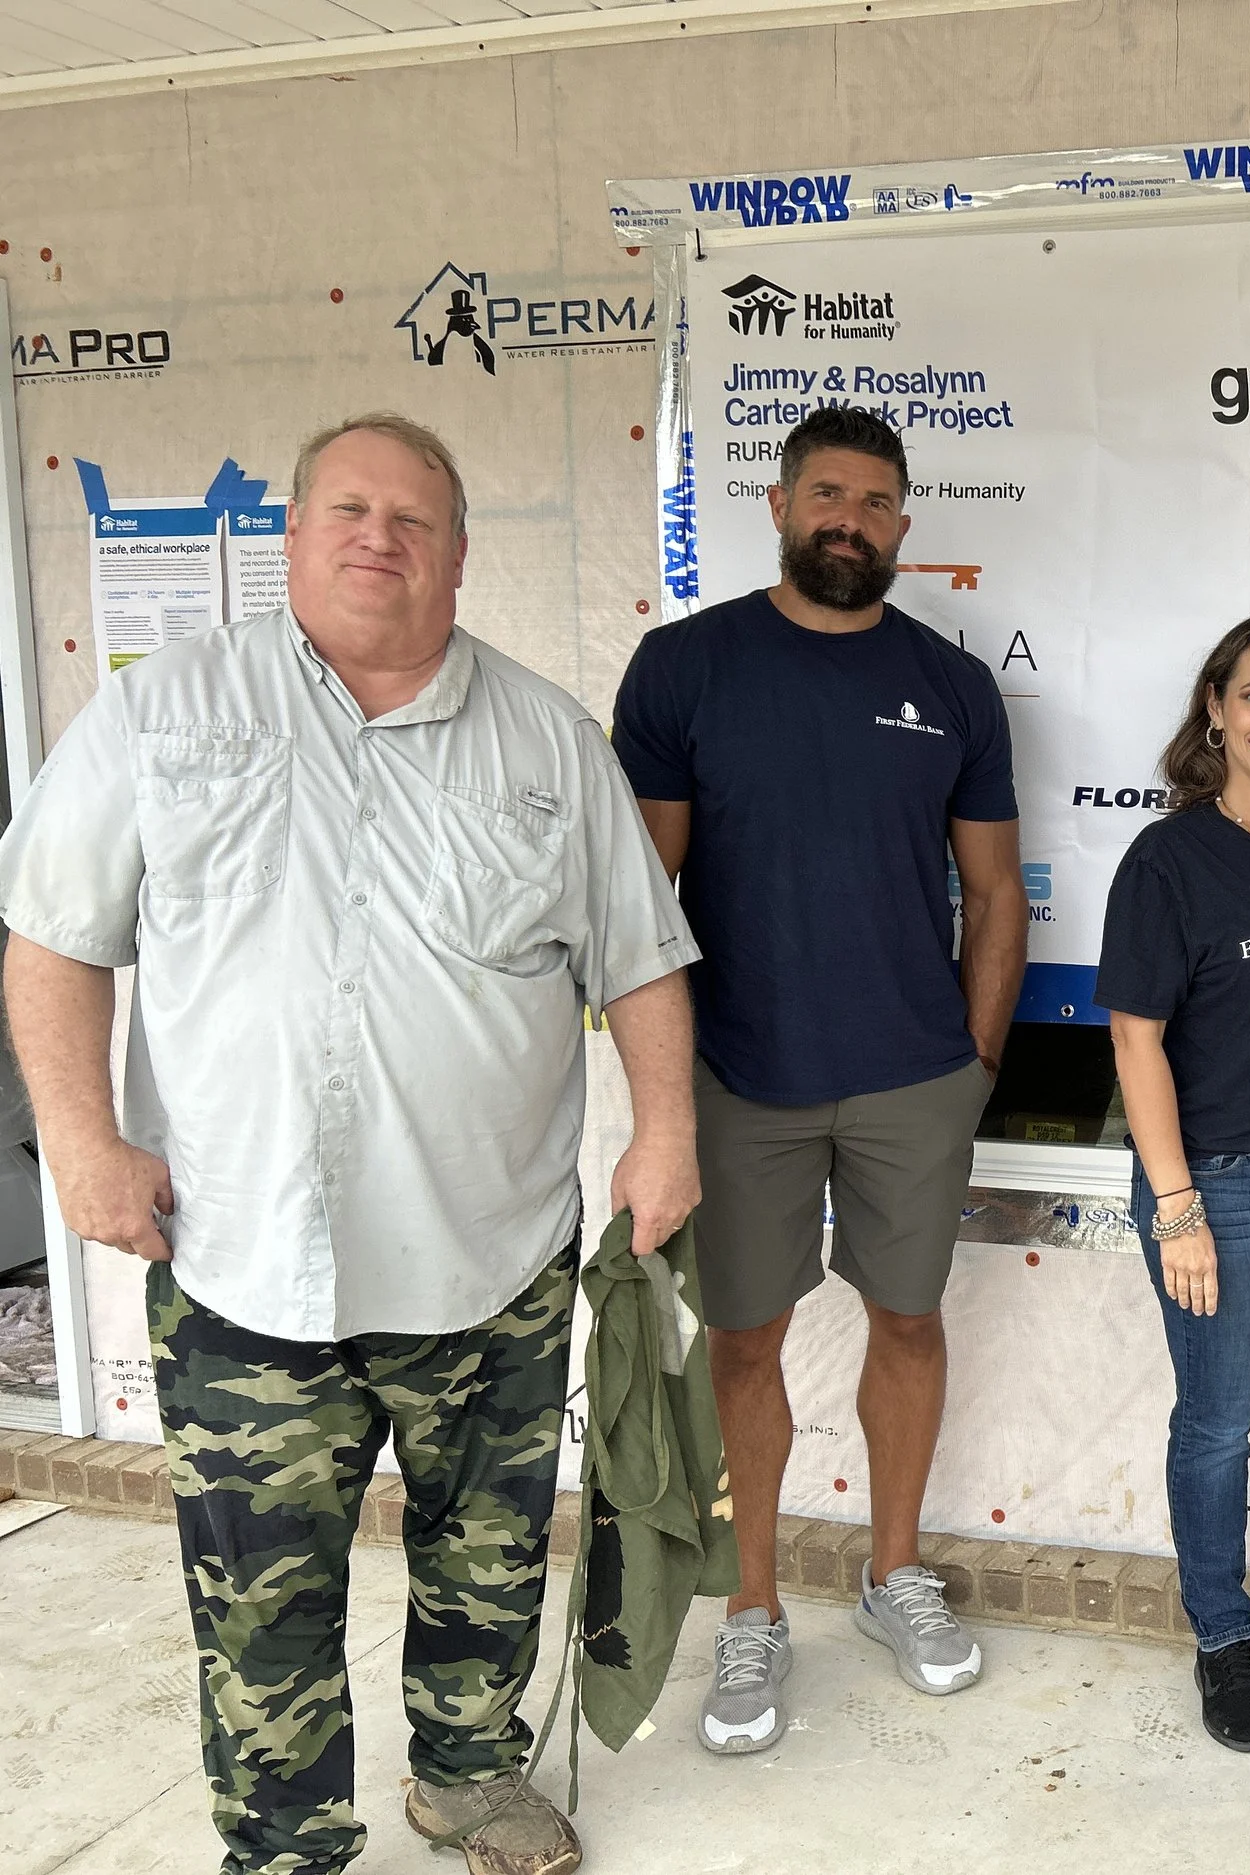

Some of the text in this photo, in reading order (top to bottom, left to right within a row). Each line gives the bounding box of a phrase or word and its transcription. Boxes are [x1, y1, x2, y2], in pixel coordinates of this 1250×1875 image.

[689, 174, 851, 211] WINDOW
[1099, 188, 1161, 199] 800.882.7663
[804, 292, 894, 321] Habitat
[804, 323, 895, 341] for Humanity
[507, 345, 647, 359] WATER RESISTANT AIR
[40, 373, 110, 384] INFILTRATION
[115, 371, 161, 380] BARRIER
[724, 363, 986, 399] Jimmy & Rosalynn
[725, 398, 810, 426] Carter
[907, 400, 1013, 434] Project
[907, 481, 933, 496] for
[939, 482, 1025, 501] Humanity
[106, 545, 128, 555] safe,
[130, 544, 161, 554] ethical
[163, 542, 210, 555] workplace
[663, 483, 688, 599] WRAP
[875, 716, 944, 735] FIRST FEDERAL BANK
